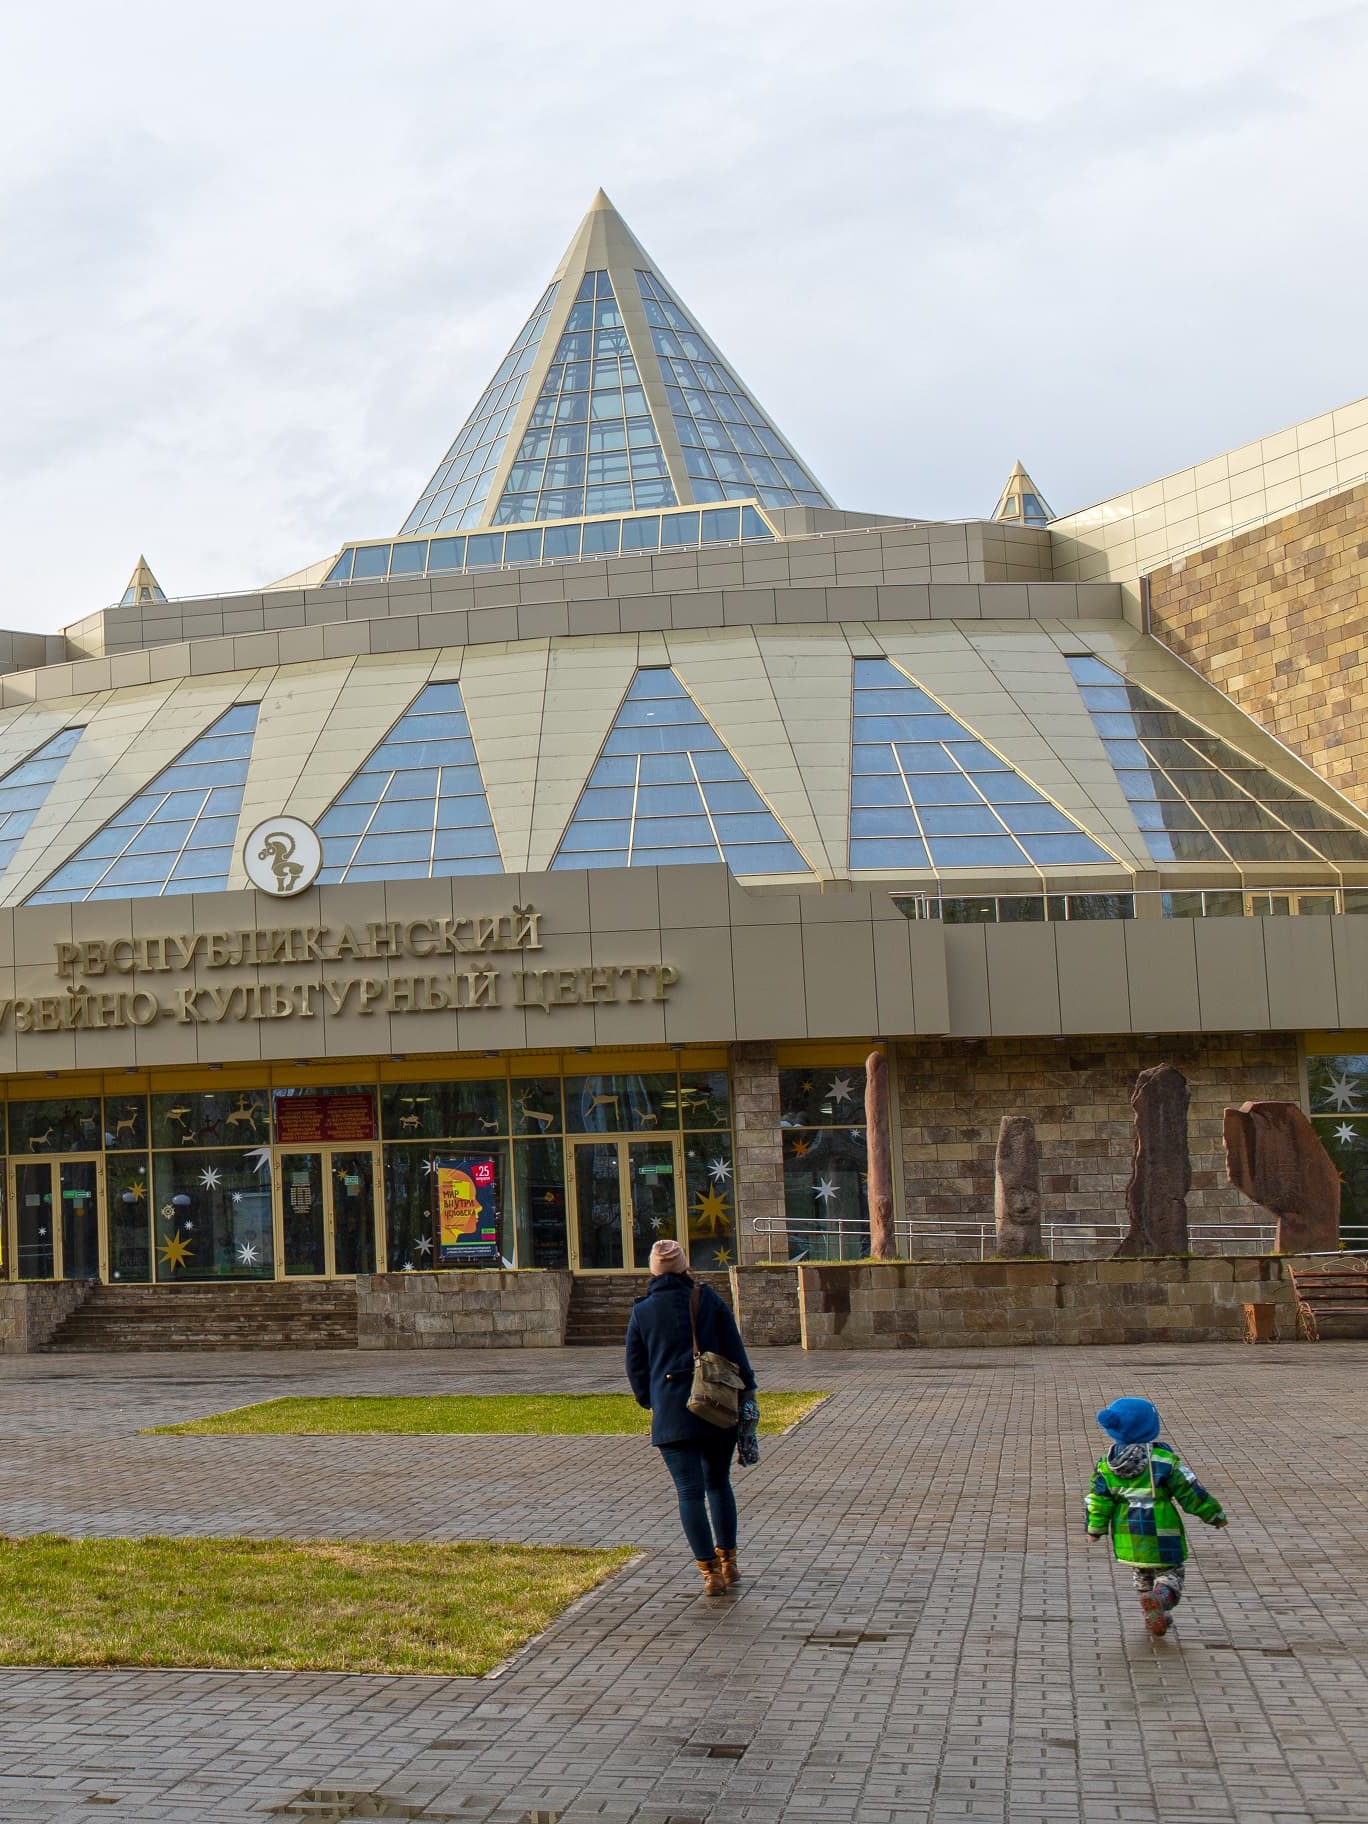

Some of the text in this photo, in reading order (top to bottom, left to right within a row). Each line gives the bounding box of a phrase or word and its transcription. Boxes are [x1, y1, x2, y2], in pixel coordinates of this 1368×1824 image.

[53, 903, 543, 977] РЕСПУБЛИКАНСКИЙ
[512, 964, 680, 1015] ЦЕНТР
[478, 1166, 489, 1176] 25
[443, 1190, 459, 1198] МИР
[444, 1200, 474, 1209] ВНУТРИ
[444, 1209, 476, 1219] ЧЕЛОВЕКА
